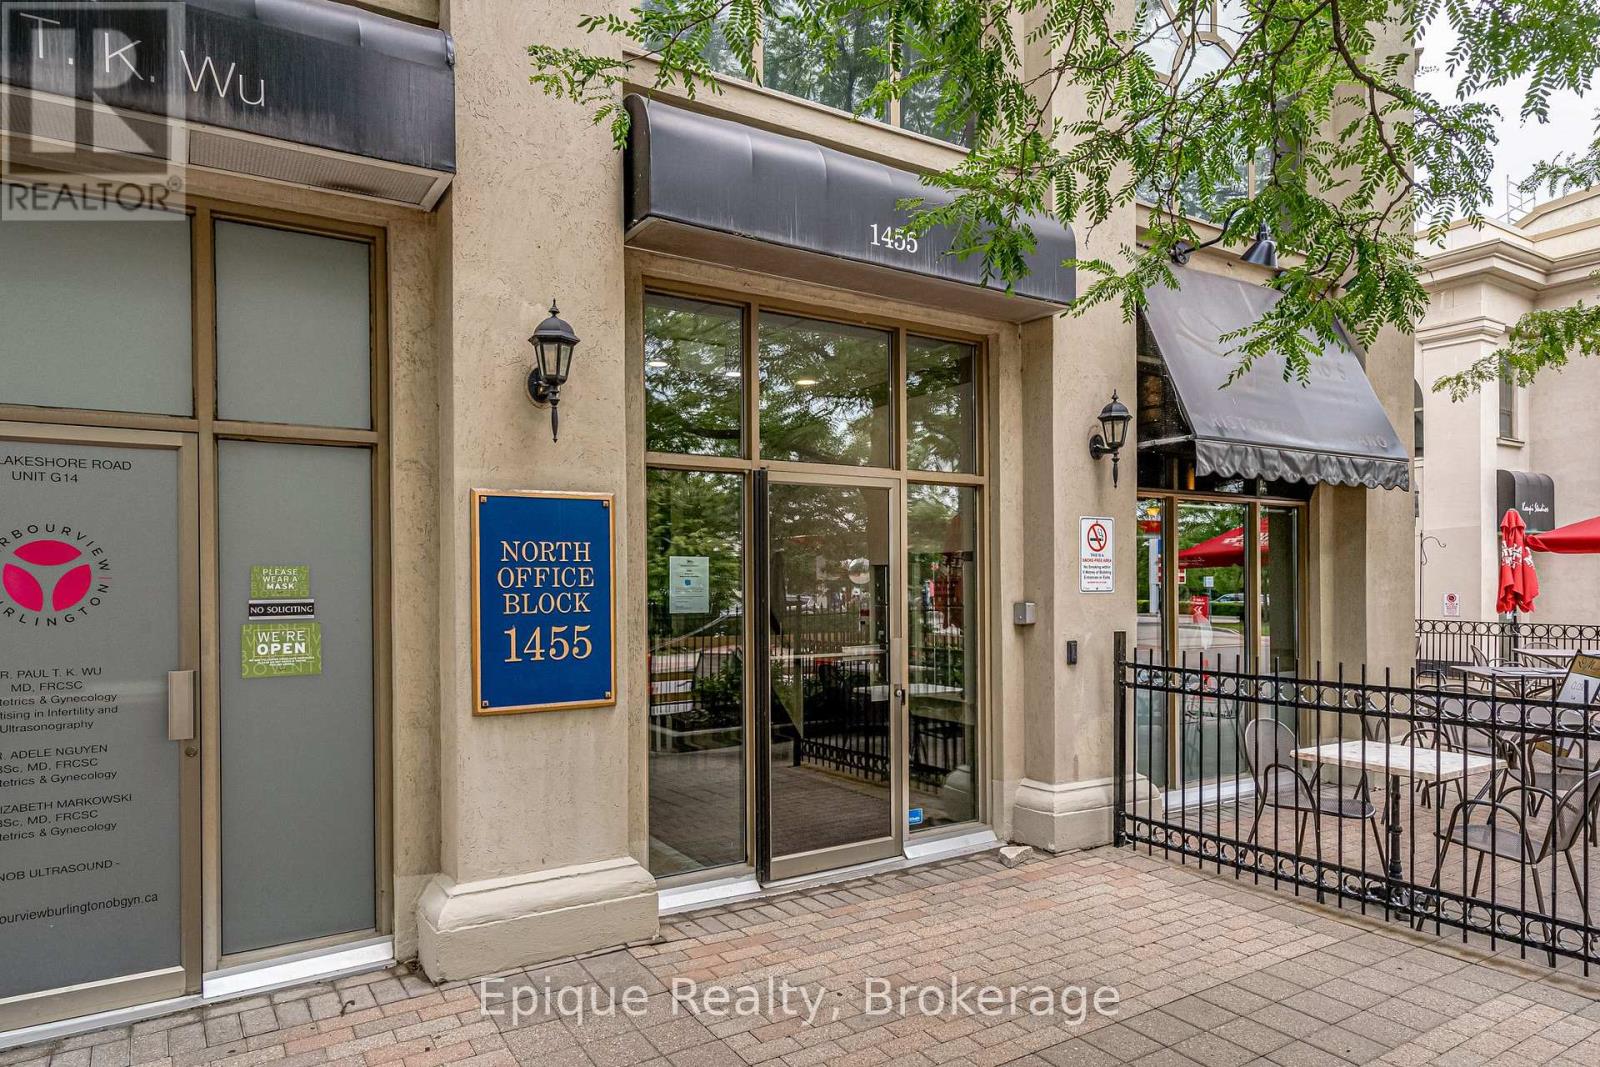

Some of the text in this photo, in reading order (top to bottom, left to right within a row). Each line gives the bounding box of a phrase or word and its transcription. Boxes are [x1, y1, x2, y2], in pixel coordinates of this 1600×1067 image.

[20, 13, 265, 107] T. K. Wu
[870, 223, 918, 253] 1455
[92, 459, 132, 471] ROAD
[12, 471, 46, 482] UNIT
[500, 540, 591, 562] NORTH
[263, 568, 297, 576] PLEASE
[497, 566, 595, 589] OFFICE
[250, 605, 313, 614] NO SOLICITING
[503, 592, 591, 615] BLOCK
[258, 630, 305, 642] WE'RE
[257, 642, 306, 656] OPEN
[504, 624, 593, 663] 1455
[17, 669, 50, 679] PAUL
[82, 667, 102, 676] WU
[40, 681, 83, 691] FRCSC
[39, 696, 47, 705] &
[50, 693, 117, 705] Gynecology
[35, 709, 44, 718] in
[47, 707, 94, 718] Infertility
[97, 705, 118, 715] and
[0, 720, 94, 733] Ultrasonography
[11, 748, 51, 759] ADELE
[55, 744, 108, 756] NGUYEN
[55, 758, 98, 770] FRCSC
[39, 775, 48, 784] &
[50, 770, 118, 784] Gynecology
[57, 793, 132, 809] MARKOWSKI
[55, 809, 98, 822] FRCSC
[39, 828, 47, 837] &
[50, 822, 117, 837] Gynecology
[29, 859, 113, 878] ULTRASOUND
